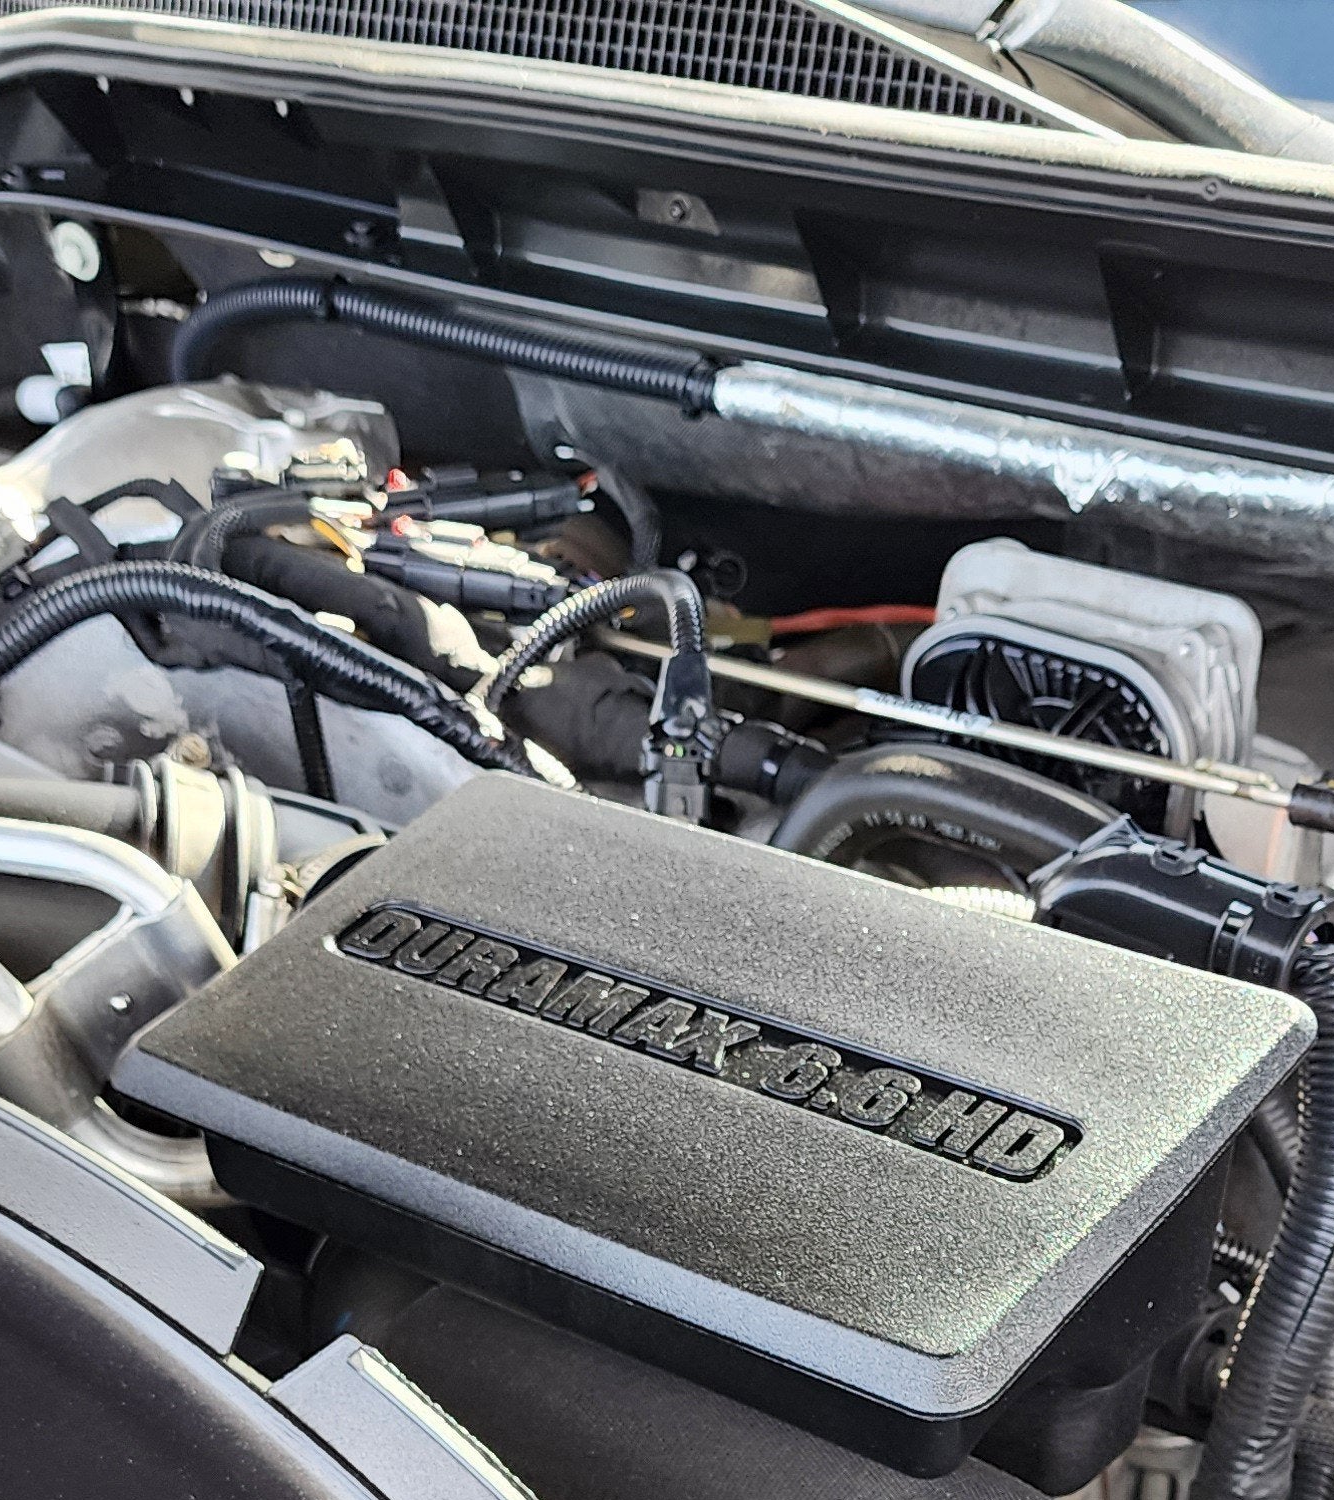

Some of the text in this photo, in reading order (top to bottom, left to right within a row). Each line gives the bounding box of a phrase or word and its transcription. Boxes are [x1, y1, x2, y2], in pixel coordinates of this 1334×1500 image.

[339, 908, 1065, 1176] DURAMAX 6.6 HD
